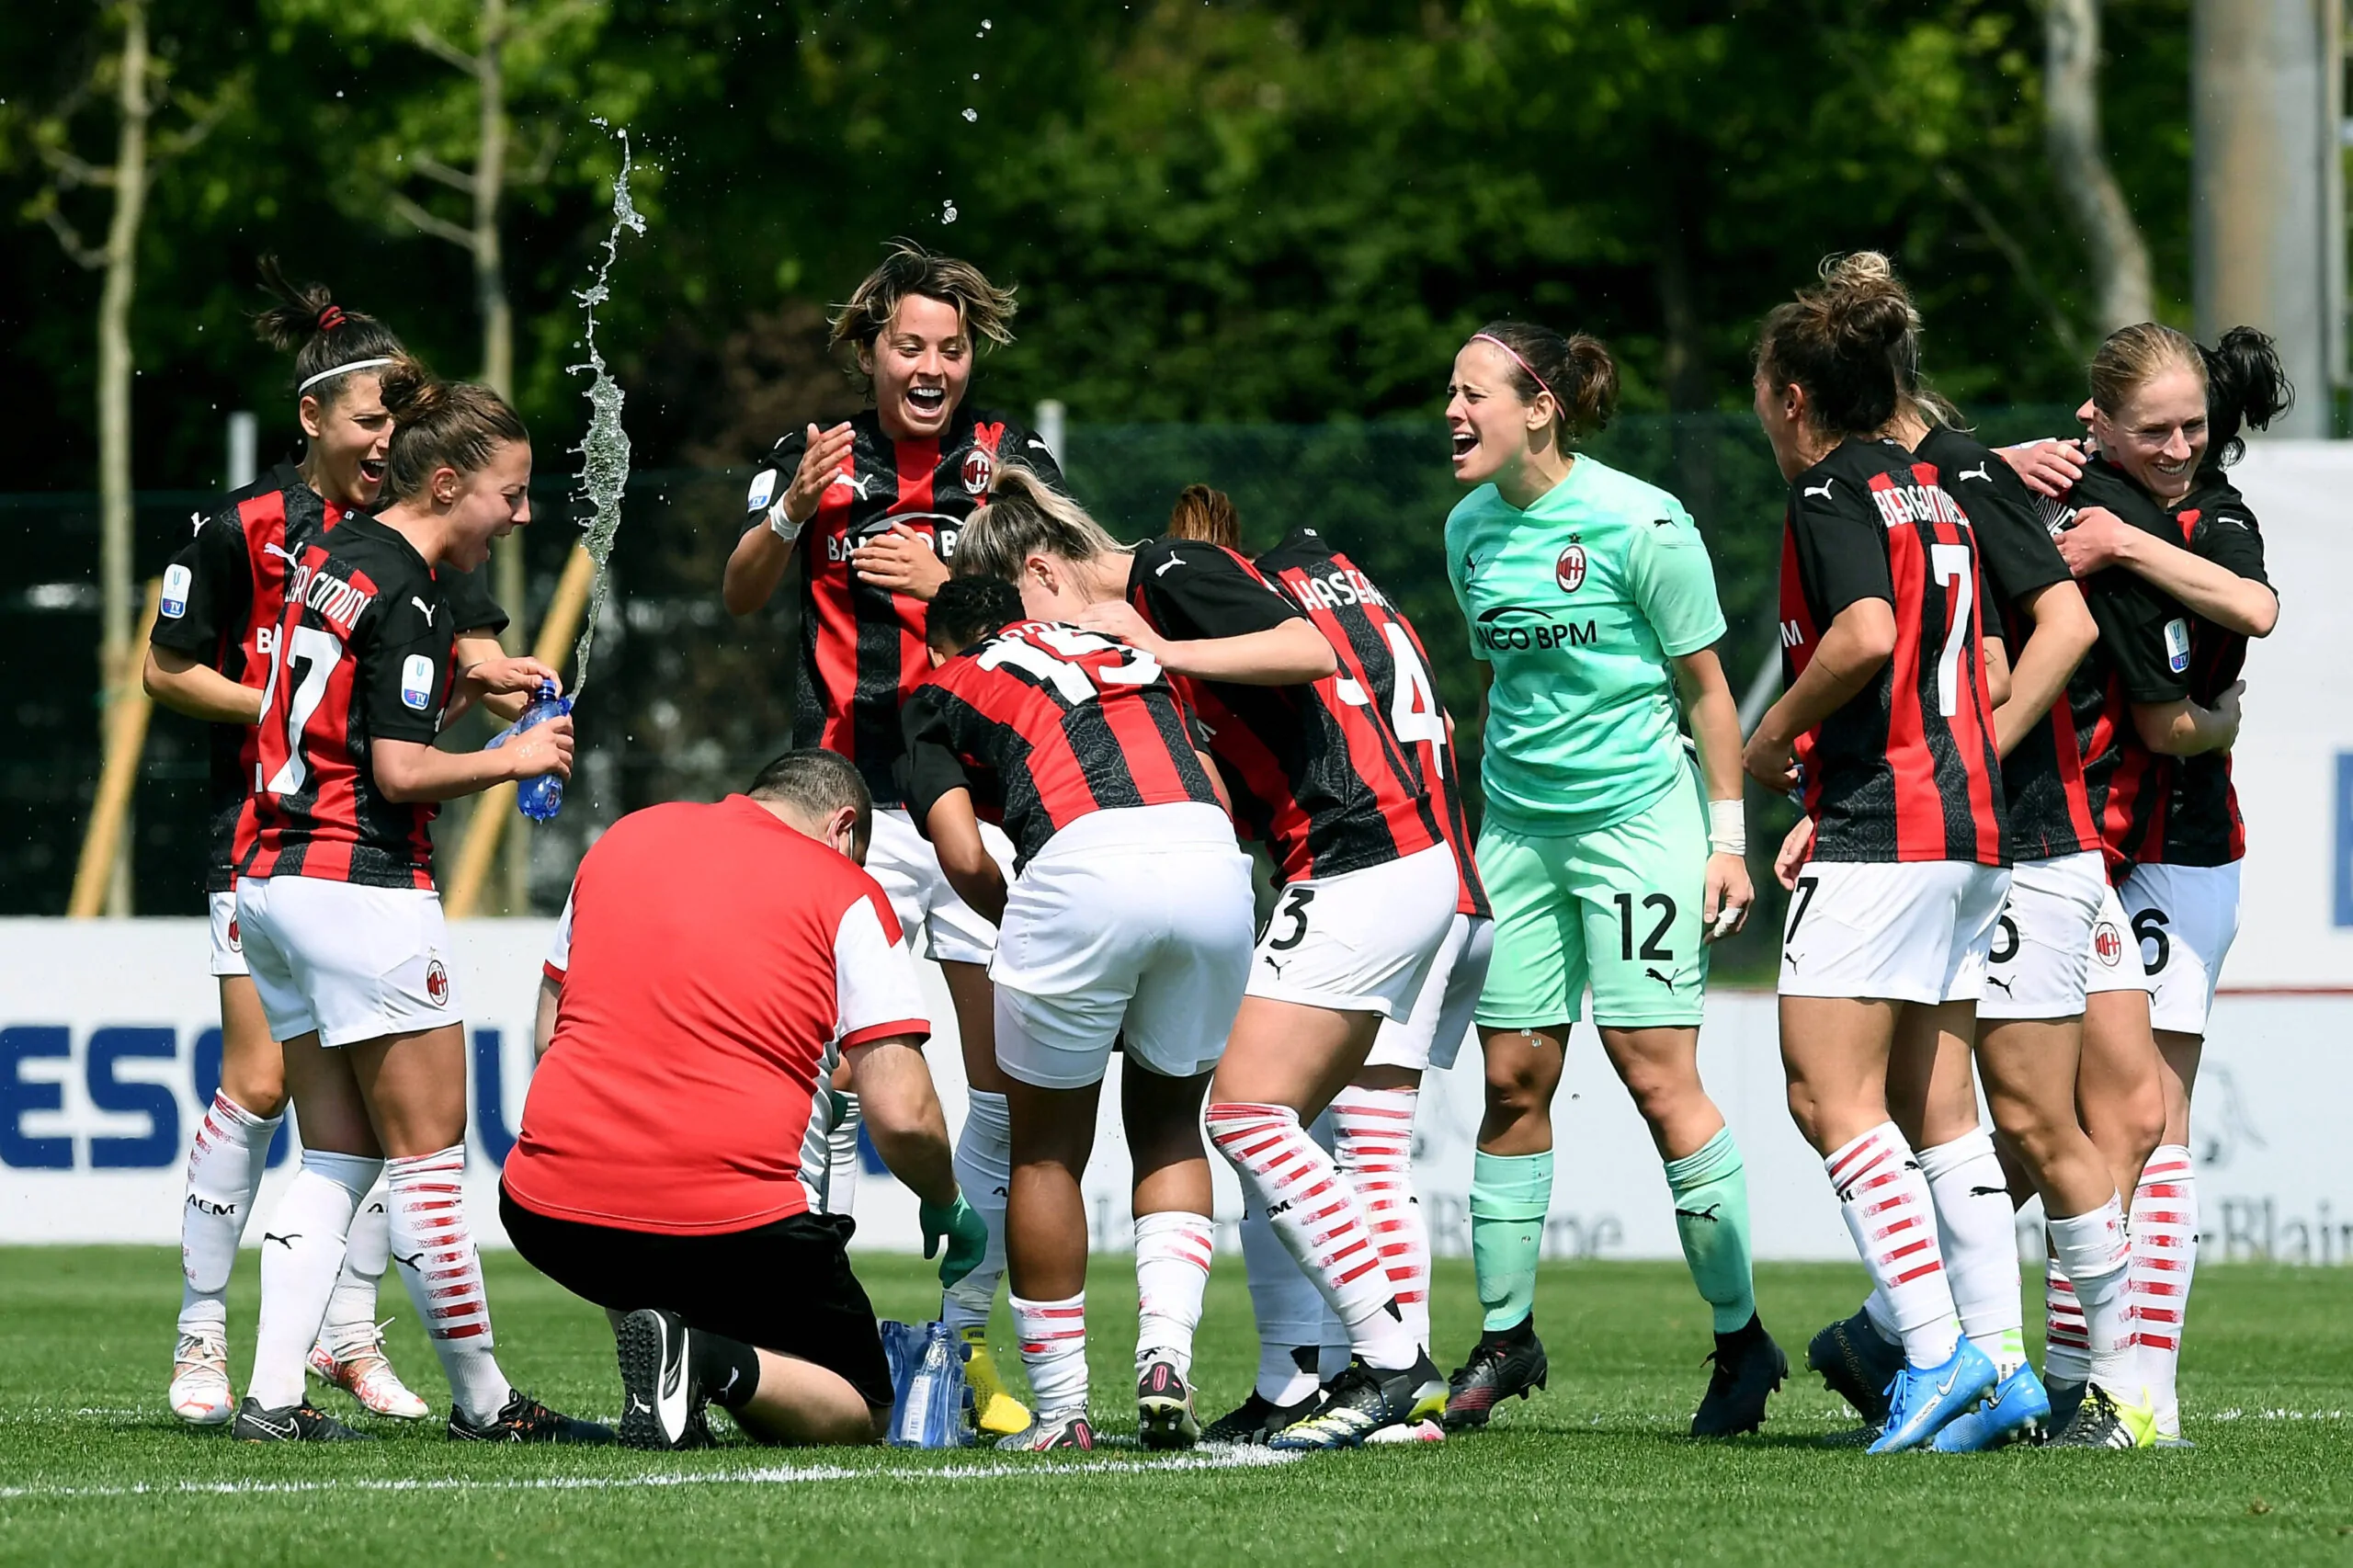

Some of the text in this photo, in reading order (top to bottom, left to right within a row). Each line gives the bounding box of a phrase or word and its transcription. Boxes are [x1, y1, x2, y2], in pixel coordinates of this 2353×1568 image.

[1534, 619, 1597, 650] BPM
[1930, 544, 1970, 717] 7
[976, 631, 1163, 706] 15
[1382, 622, 1448, 780] 4
[1613, 892, 1677, 961] 12
[1785, 877, 1819, 945] 7
[2131, 907, 2170, 976] 6
[187, 1193, 238, 1215] ACM
